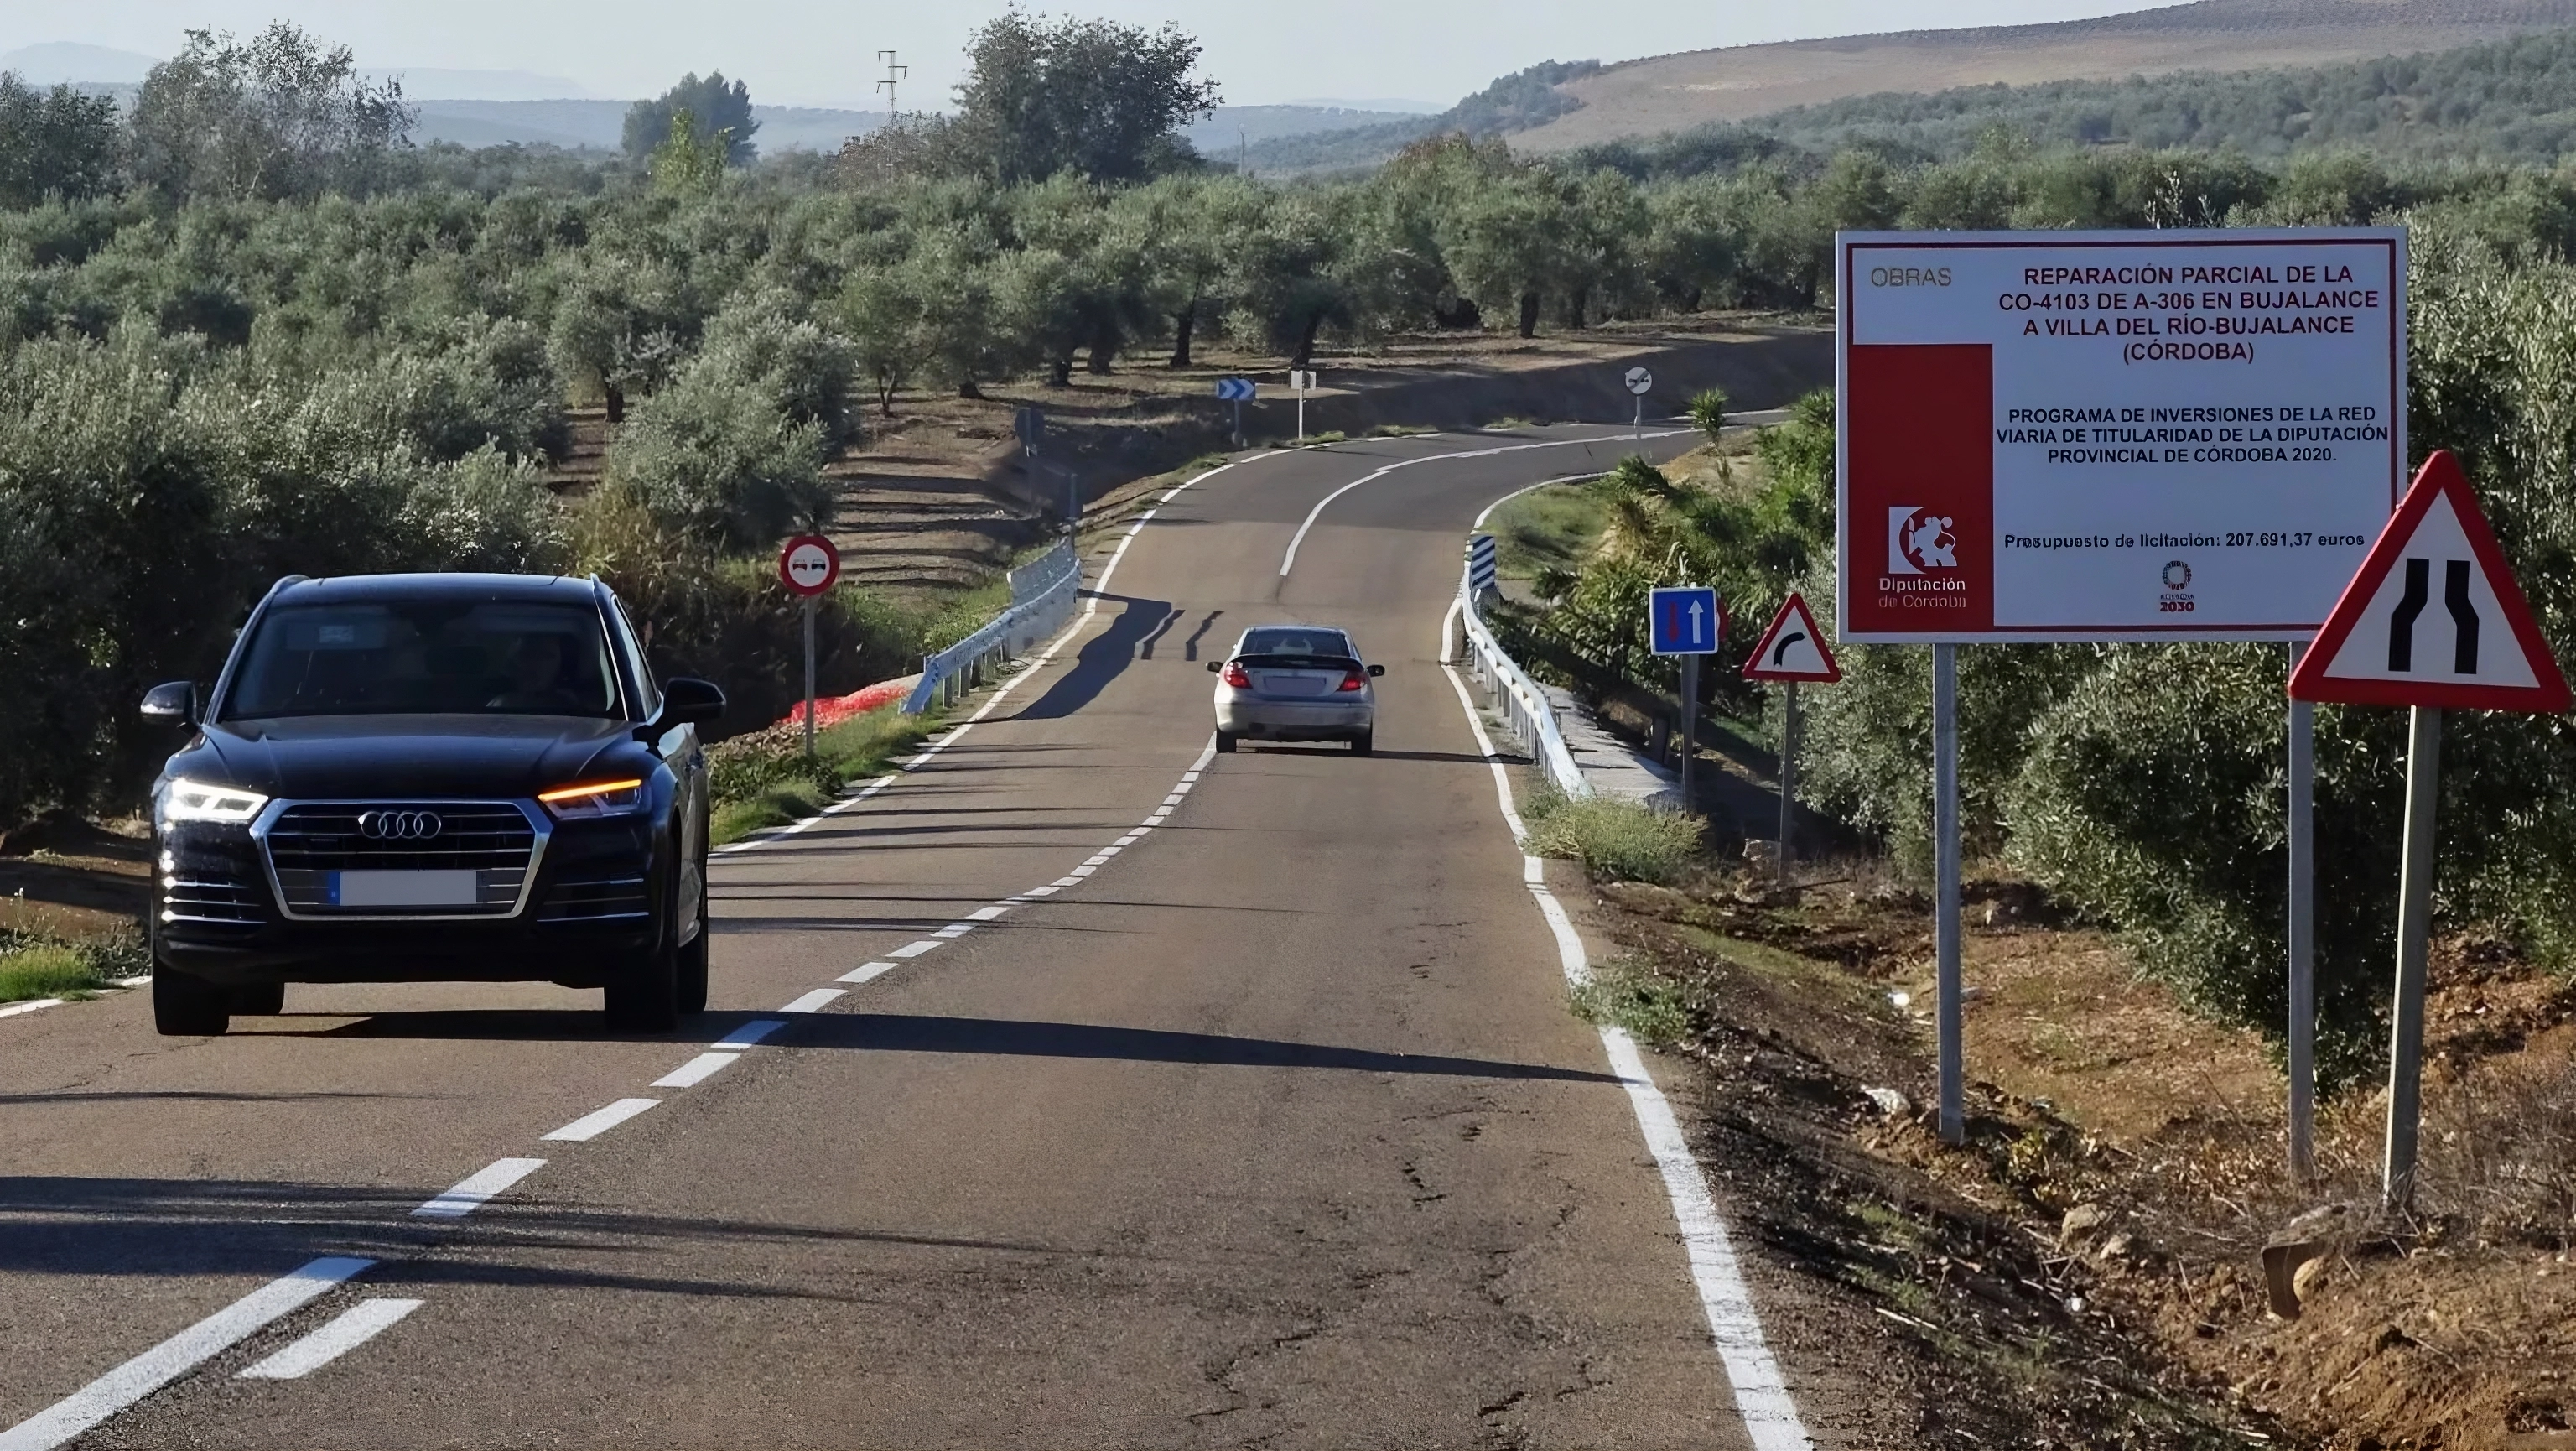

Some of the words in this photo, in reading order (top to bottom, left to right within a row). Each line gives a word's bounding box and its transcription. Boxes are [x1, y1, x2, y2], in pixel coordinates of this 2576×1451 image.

[1871, 267, 1952, 288] OBRAS
[2024, 262, 2174, 287] REPARACIÓN
[2181, 265, 2280, 285] PARCIAL
[2286, 265, 2316, 283] DE
[2324, 264, 2354, 284] LA
[1999, 292, 2090, 312] CO-4103
[2097, 292, 2127, 310] DE
[2132, 291, 2194, 311] A-306
[2202, 291, 2232, 309] EN
[2240, 290, 2379, 309] BUJALANCE
[2023, 319, 2039, 336] A
[2044, 317, 2111, 337] VILLA
[2116, 317, 2161, 335] DEL
[2168, 311, 2355, 336] RÍO-BUJALANCE
[2122, 338, 2254, 367] (CÓRDOBA)
[2008, 407, 2116, 424] PROGRAMA
[2121, 408, 2145, 423] DE
[2150, 407, 2274, 424] INVERSIONES
[2279, 407, 2304, 422] DE
[2309, 406, 2334, 422] LA
[2338, 406, 2376, 421] RED
[1996, 429, 2058, 444] VIARIA
[2062, 429, 2087, 444] DE
[2091, 427, 2213, 444] TITULARIDAD
[2219, 428, 2244, 443] DE
[2249, 427, 2273, 442] LA
[2277, 423, 2388, 443] DIPUTACIÓN
[2048, 447, 2159, 464] PROVINCIAL
[2164, 448, 2189, 463] DE
[2194, 444, 2288, 464] CÓRDOBA
[2292, 447, 2337, 463] 2020.
[2004, 533, 2110, 551] Presupuesto
[2114, 533, 2135, 549] de
[2140, 533, 2220, 548] licitación:
[2225, 531, 2313, 549] 207.691,37
[2317, 534, 2366, 547] euros
[1878, 577, 1966, 594] Diputación
